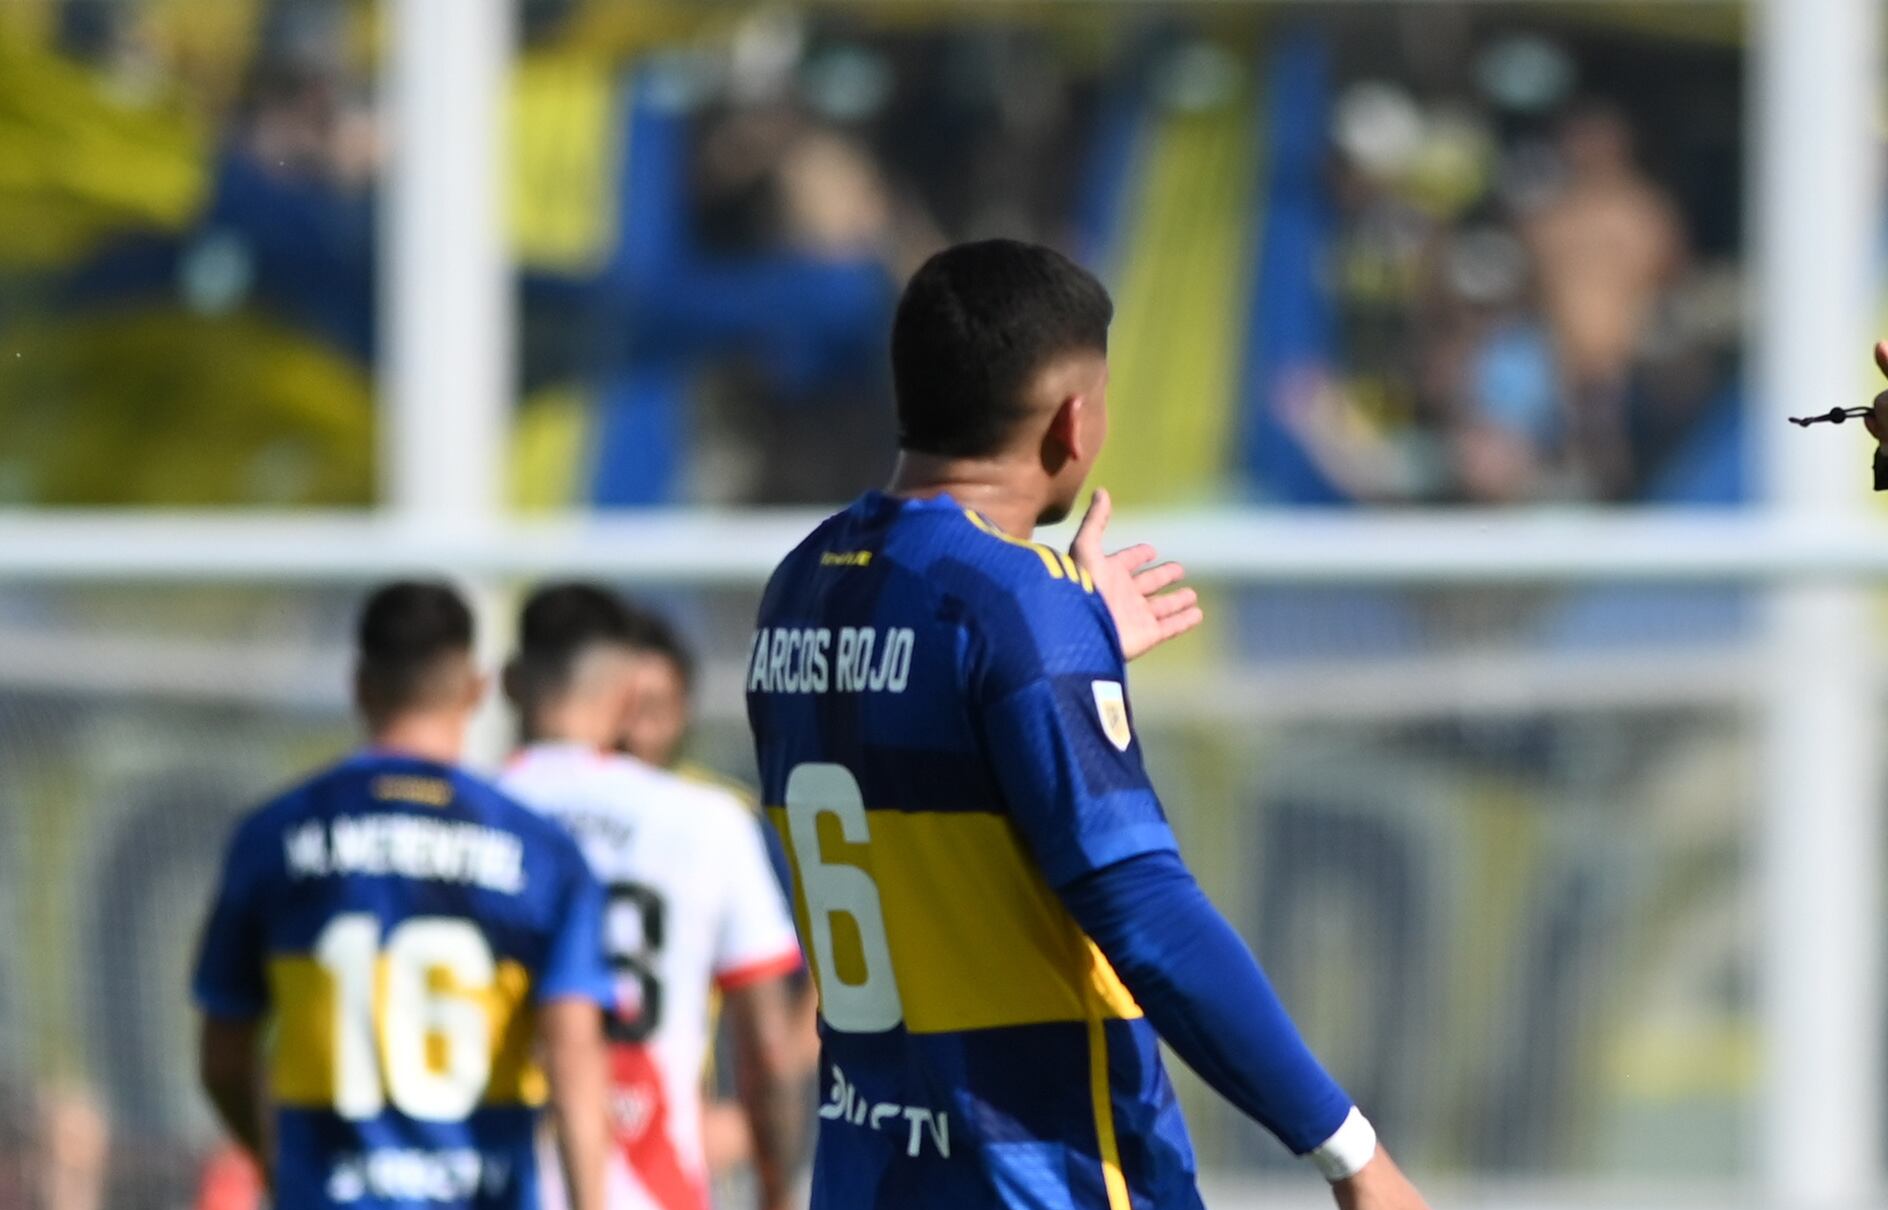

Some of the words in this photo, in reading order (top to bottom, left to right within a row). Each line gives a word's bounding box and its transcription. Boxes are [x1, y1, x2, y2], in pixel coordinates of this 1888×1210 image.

[750, 627, 831, 693] ARCOS
[836, 626, 915, 692] ROJO
[786, 762, 904, 1034] 6
[315, 912, 497, 1123] 16
